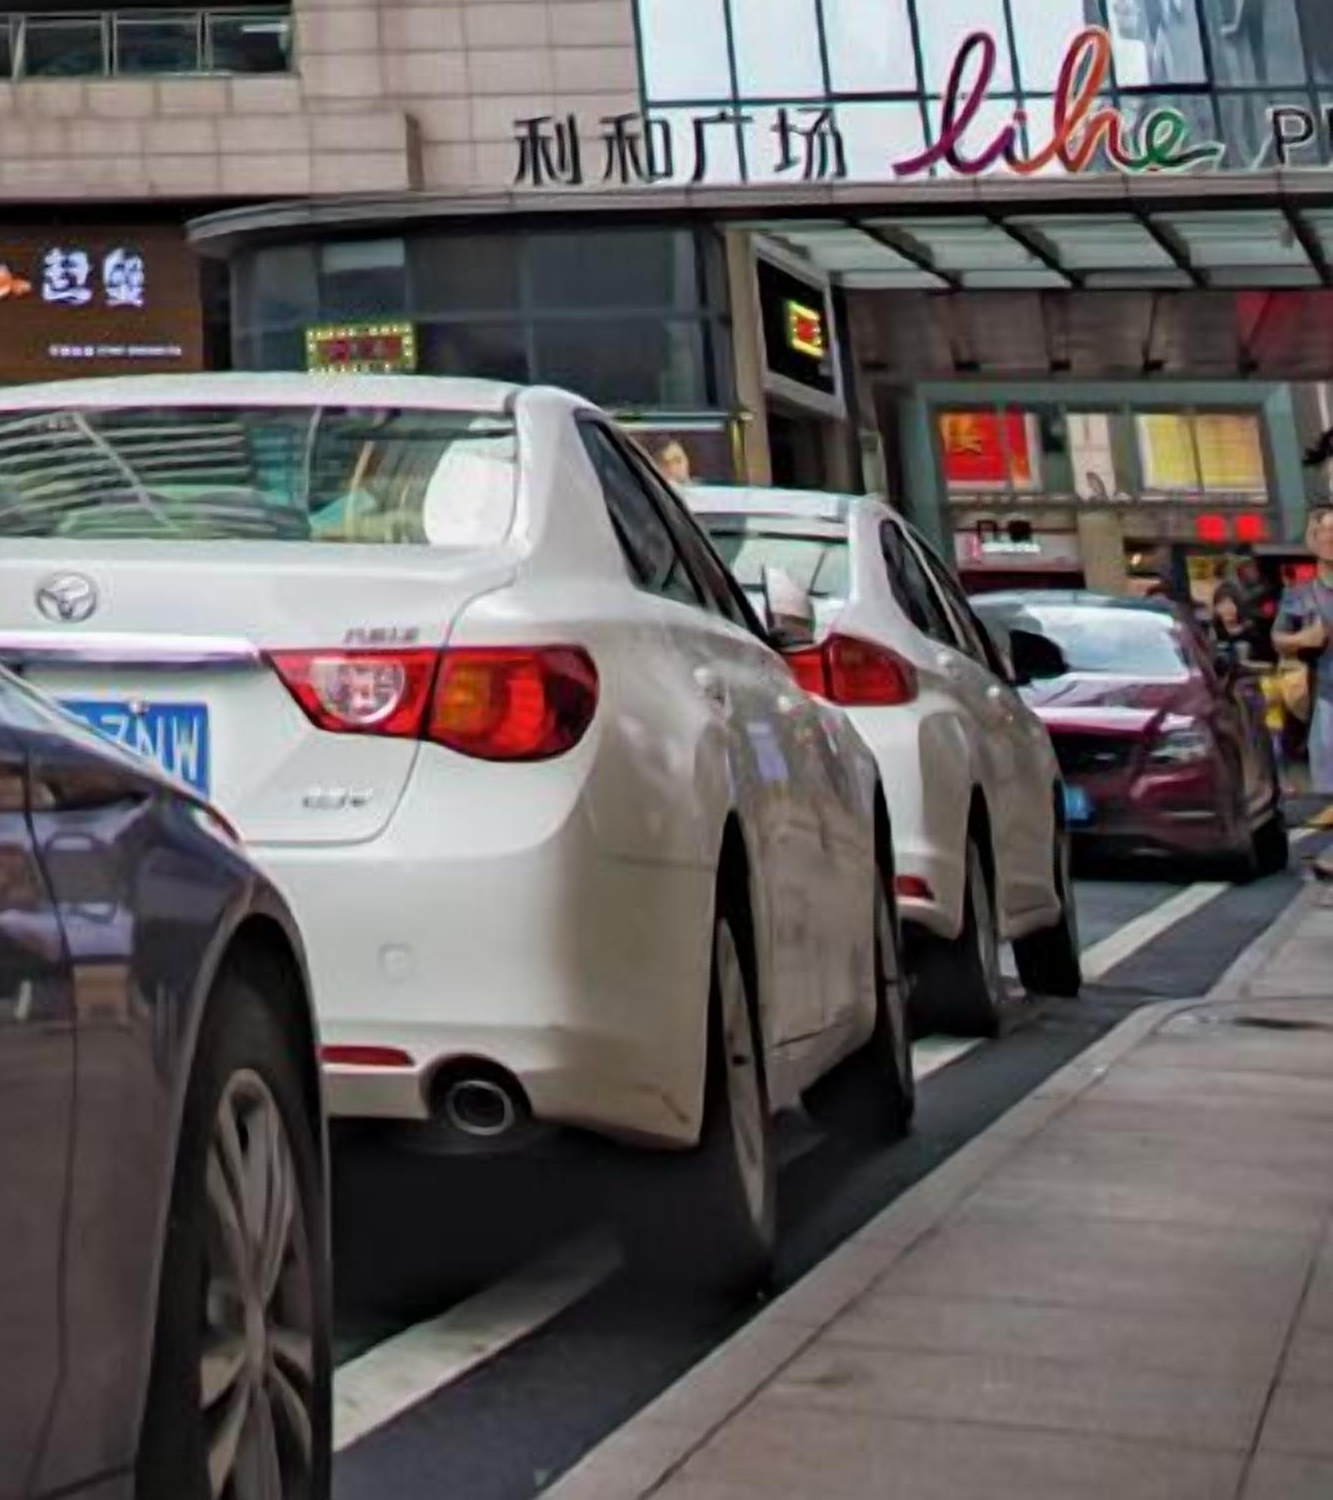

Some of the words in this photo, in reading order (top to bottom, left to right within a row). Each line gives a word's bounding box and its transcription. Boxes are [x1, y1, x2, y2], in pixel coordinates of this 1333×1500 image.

[513, 106, 848, 186] 利和广场
[891, 26, 1225, 177] lihe
[1268, 105, 1333, 165] P
